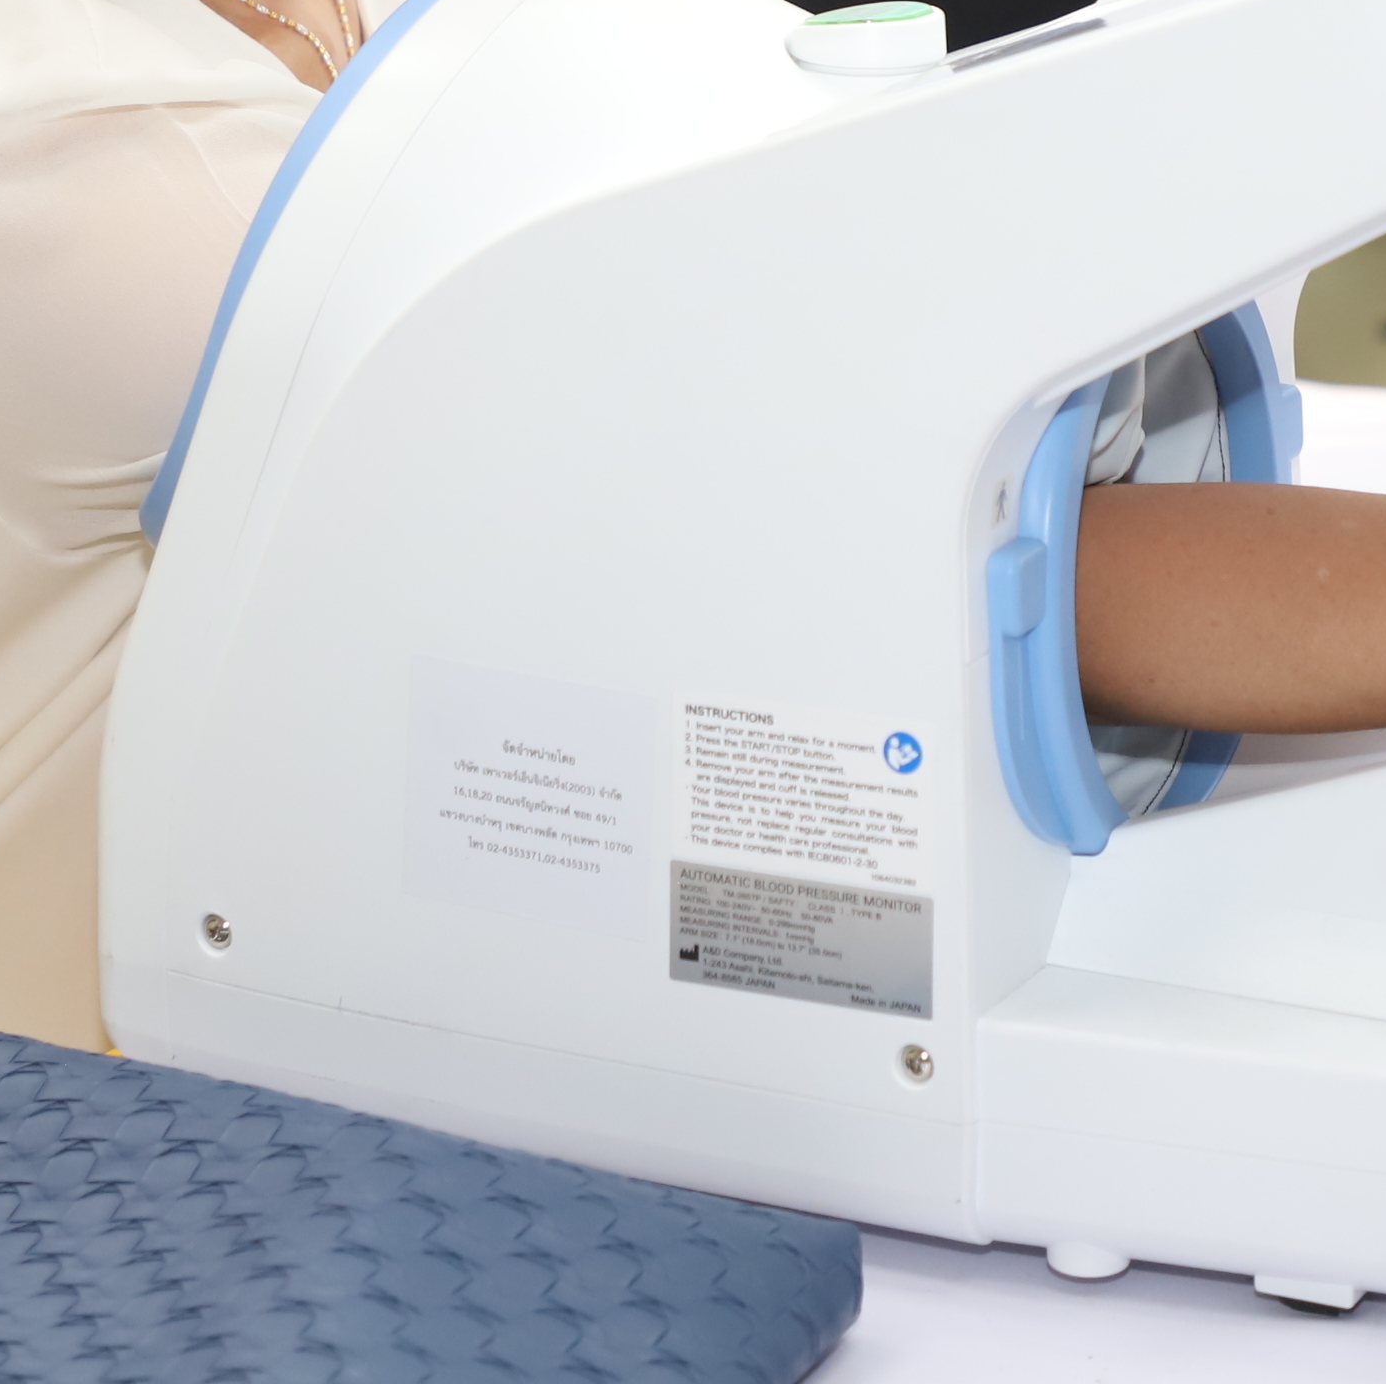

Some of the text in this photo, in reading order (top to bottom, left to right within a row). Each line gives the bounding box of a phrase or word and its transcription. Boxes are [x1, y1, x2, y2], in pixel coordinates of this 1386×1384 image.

[685, 704, 774, 725] INSTRUCTIONS
[696, 722, 721, 732] Insert
[724, 727, 744, 736] your
[748, 730, 765, 738] arm
[768, 732, 785, 741] and
[788, 734, 809, 744] relax
[812, 736, 825, 746] for
[696, 734, 721, 745] Press
[724, 738, 738, 747] the
[741, 740, 801, 755] START/STOP
[502, 739, 575, 766] จัดจำหน่ายโดย
[696, 747, 729, 758] Remain
[732, 751, 747, 761] still
[749, 754, 778, 767] during
[696, 760, 731, 772] Remove
[735, 767, 754, 775] your
[758, 769, 776, 777] arm
[778, 771, 800, 781] after
[803, 775, 818, 784] the
[821, 778, 884, 793] measurement
[887, 786, 918, 798] results
[696, 774, 711, 782] are
[714, 775, 756, 789] displayed
[759, 782, 776, 791] and
[778, 784, 797, 794] cuff
[691, 784, 711, 794] Your
[714, 788, 740, 799] blood
[742, 793, 782, 805] pressure
[784, 799, 812, 809] varies
[814, 801, 866, 816] throughout
[869, 809, 883, 818] the
[691, 796, 709, 807] This
[714, 801, 743, 812] device
[761, 807, 770, 815] to
[775, 808, 795, 820] help
[800, 814, 816, 823] you
[821, 816, 861, 828] measure
[866, 823, 886, 832] your
[892, 825, 918, 837] blood
[691, 810, 918, 849] pressure, not replace regular consultations with
[691, 824, 710, 833] your
[714, 826, 743, 837] doctor
[747, 831, 755, 839] or
[759, 832, 786, 843] health
[789, 837, 809, 846] care
[604, 840, 633, 855] 10700
[691, 834, 709, 845] This
[711, 838, 740, 849] device
[743, 843, 782, 856] complies
[786, 849, 805, 859] with
[680, 868, 921, 914] AUTOMATIC BLOOD PRESSURE MONITOR
[745, 977, 775, 990] JAPAN
[851, 994, 876, 1007] Made
[889, 1000, 921, 1013] JAPAN
